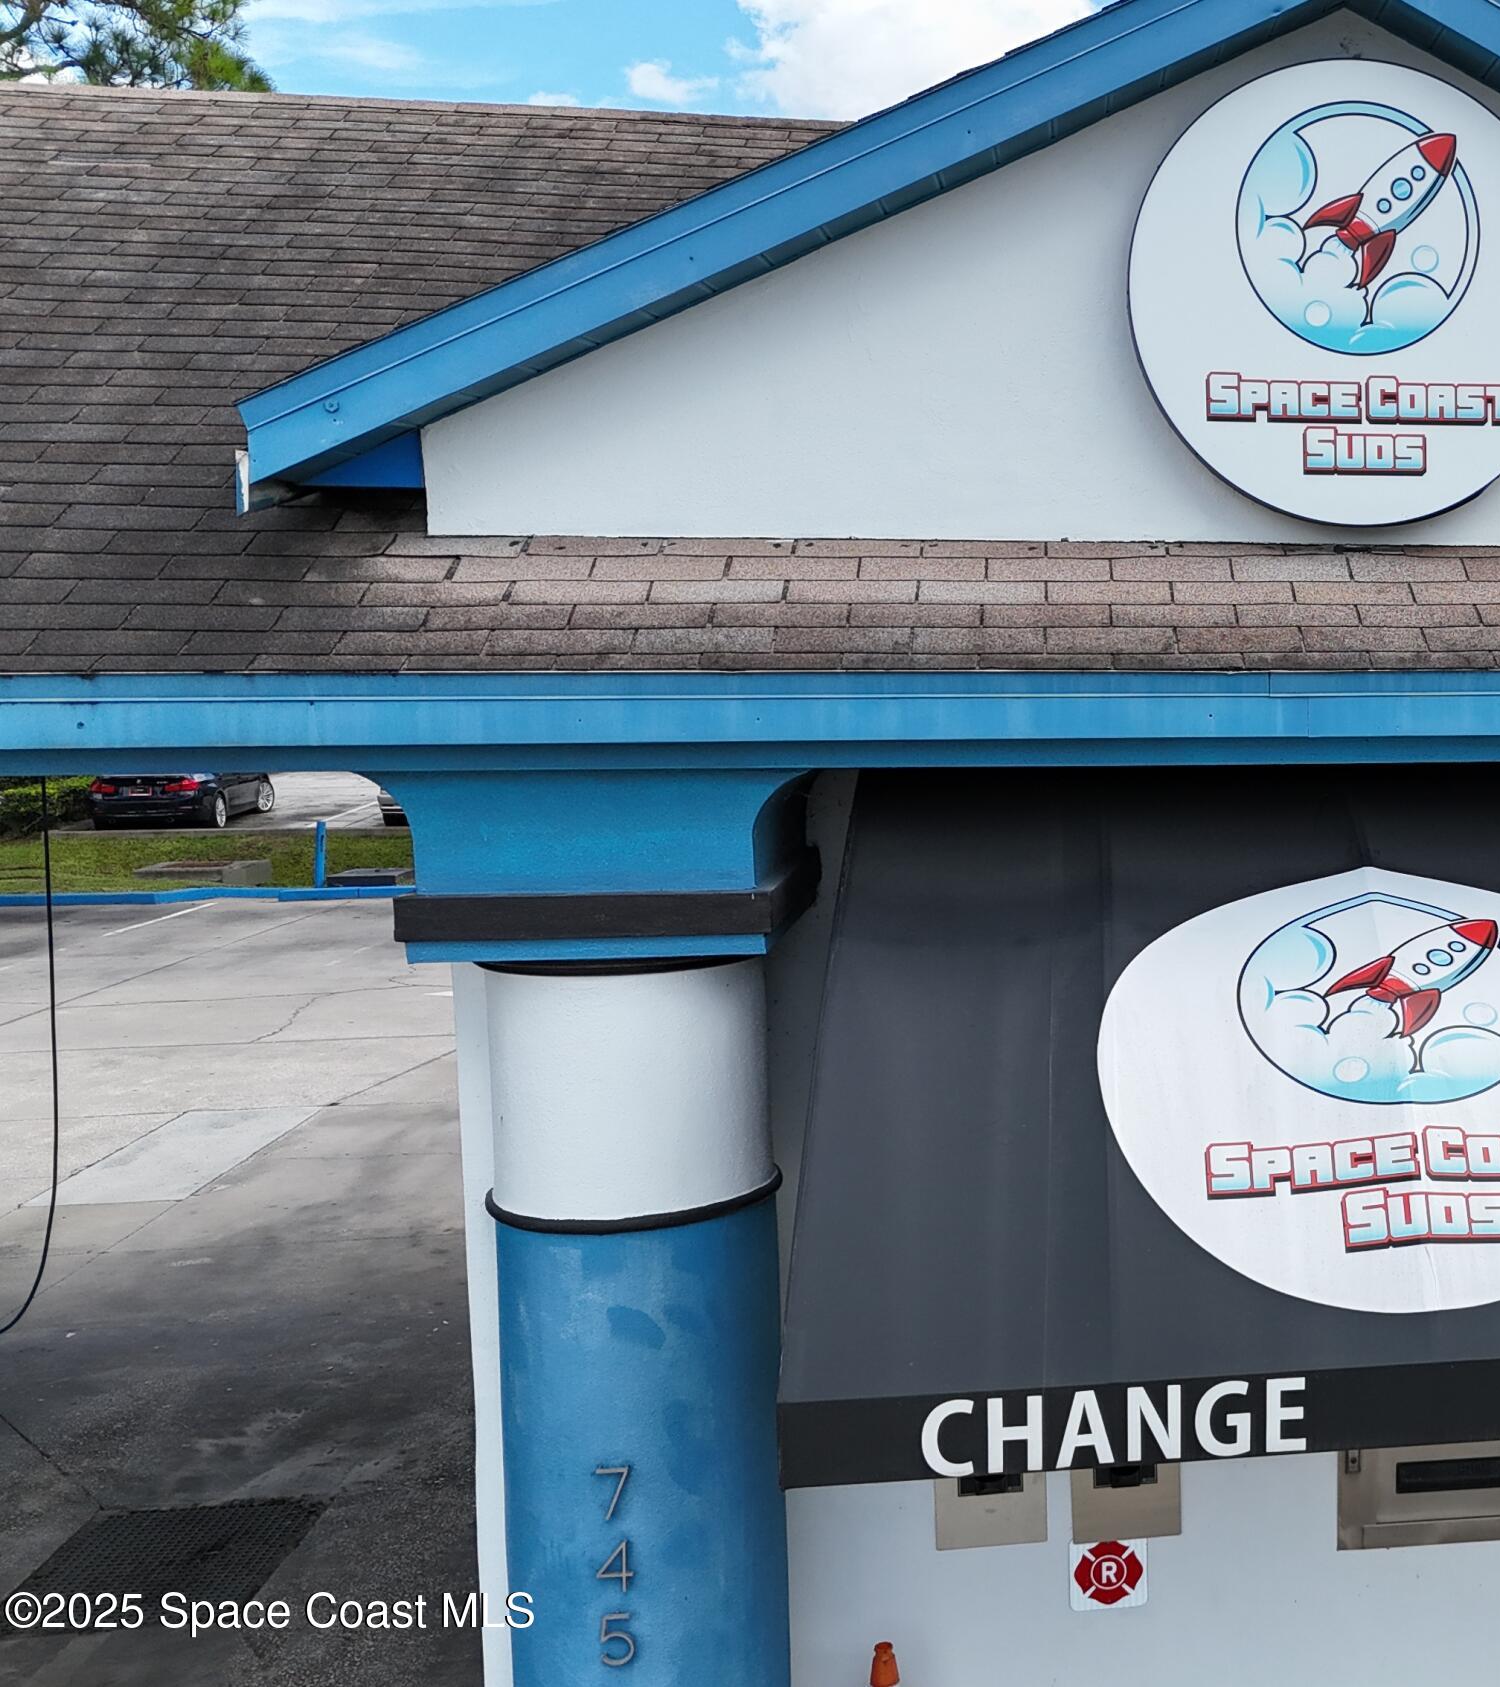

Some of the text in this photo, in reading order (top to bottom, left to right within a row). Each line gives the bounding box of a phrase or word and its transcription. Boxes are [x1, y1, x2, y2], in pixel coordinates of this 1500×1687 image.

[1206, 371, 1362, 424] SPACE
[1303, 426, 1427, 476] SUDS
[1204, 1131, 1422, 1200] SPACE
[920, 1375, 1308, 1479] CHANGE
[1101, 1561, 1117, 1584] R
